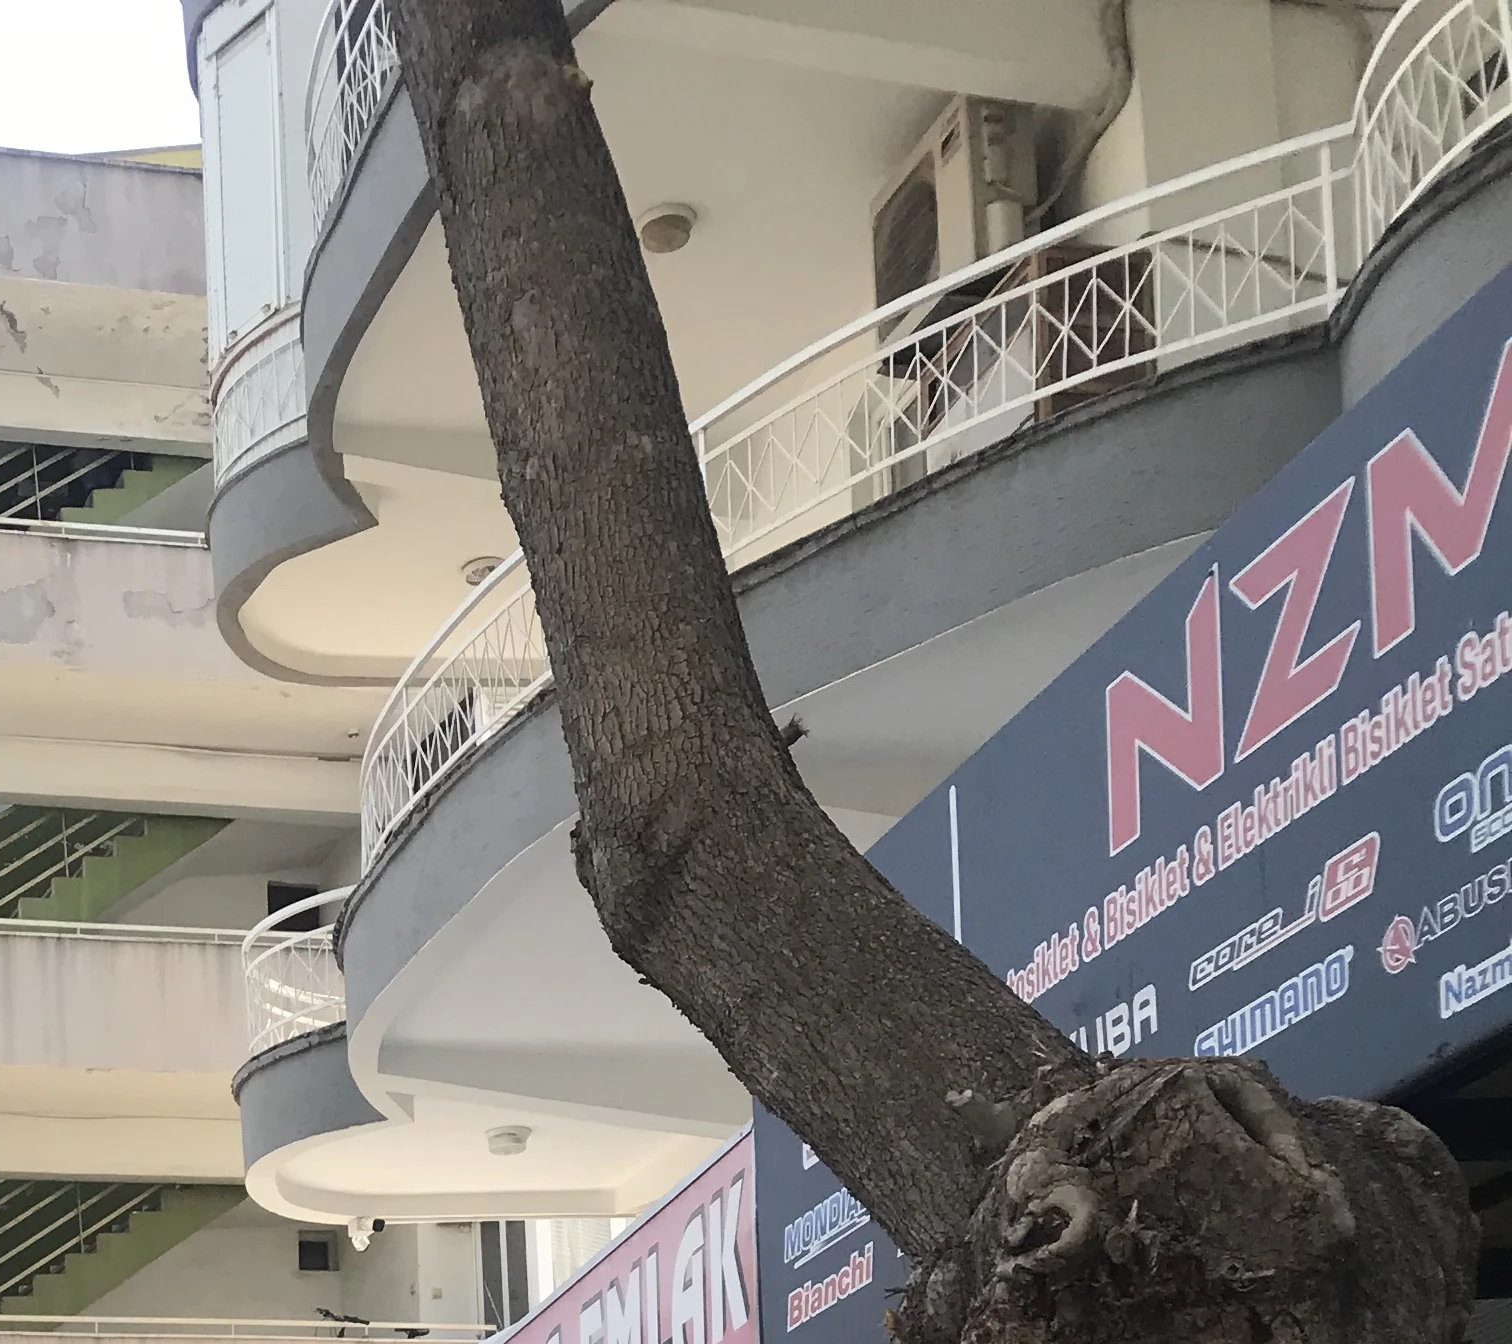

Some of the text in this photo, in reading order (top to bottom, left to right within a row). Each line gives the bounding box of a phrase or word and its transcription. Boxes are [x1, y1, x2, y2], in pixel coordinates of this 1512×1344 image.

[1106, 337, 1512, 857] NZM
[1006, 922, 1079, 1004] tosiklet
[1082, 906, 1102, 962] &
[1104, 844, 1190, 950] Bisiklet
[1193, 826, 1216, 886] &
[1217, 733, 1338, 871] Elektrikli
[1340, 655, 1453, 786] Bisiklet
[1415, 857, 1512, 950] ABUS
[1070, 984, 1158, 1058] UBA
[1194, 950, 1351, 1057] SHIMANO
[784, 1187, 868, 1263] MONDIA
[787, 1241, 874, 1333] Bianchi
